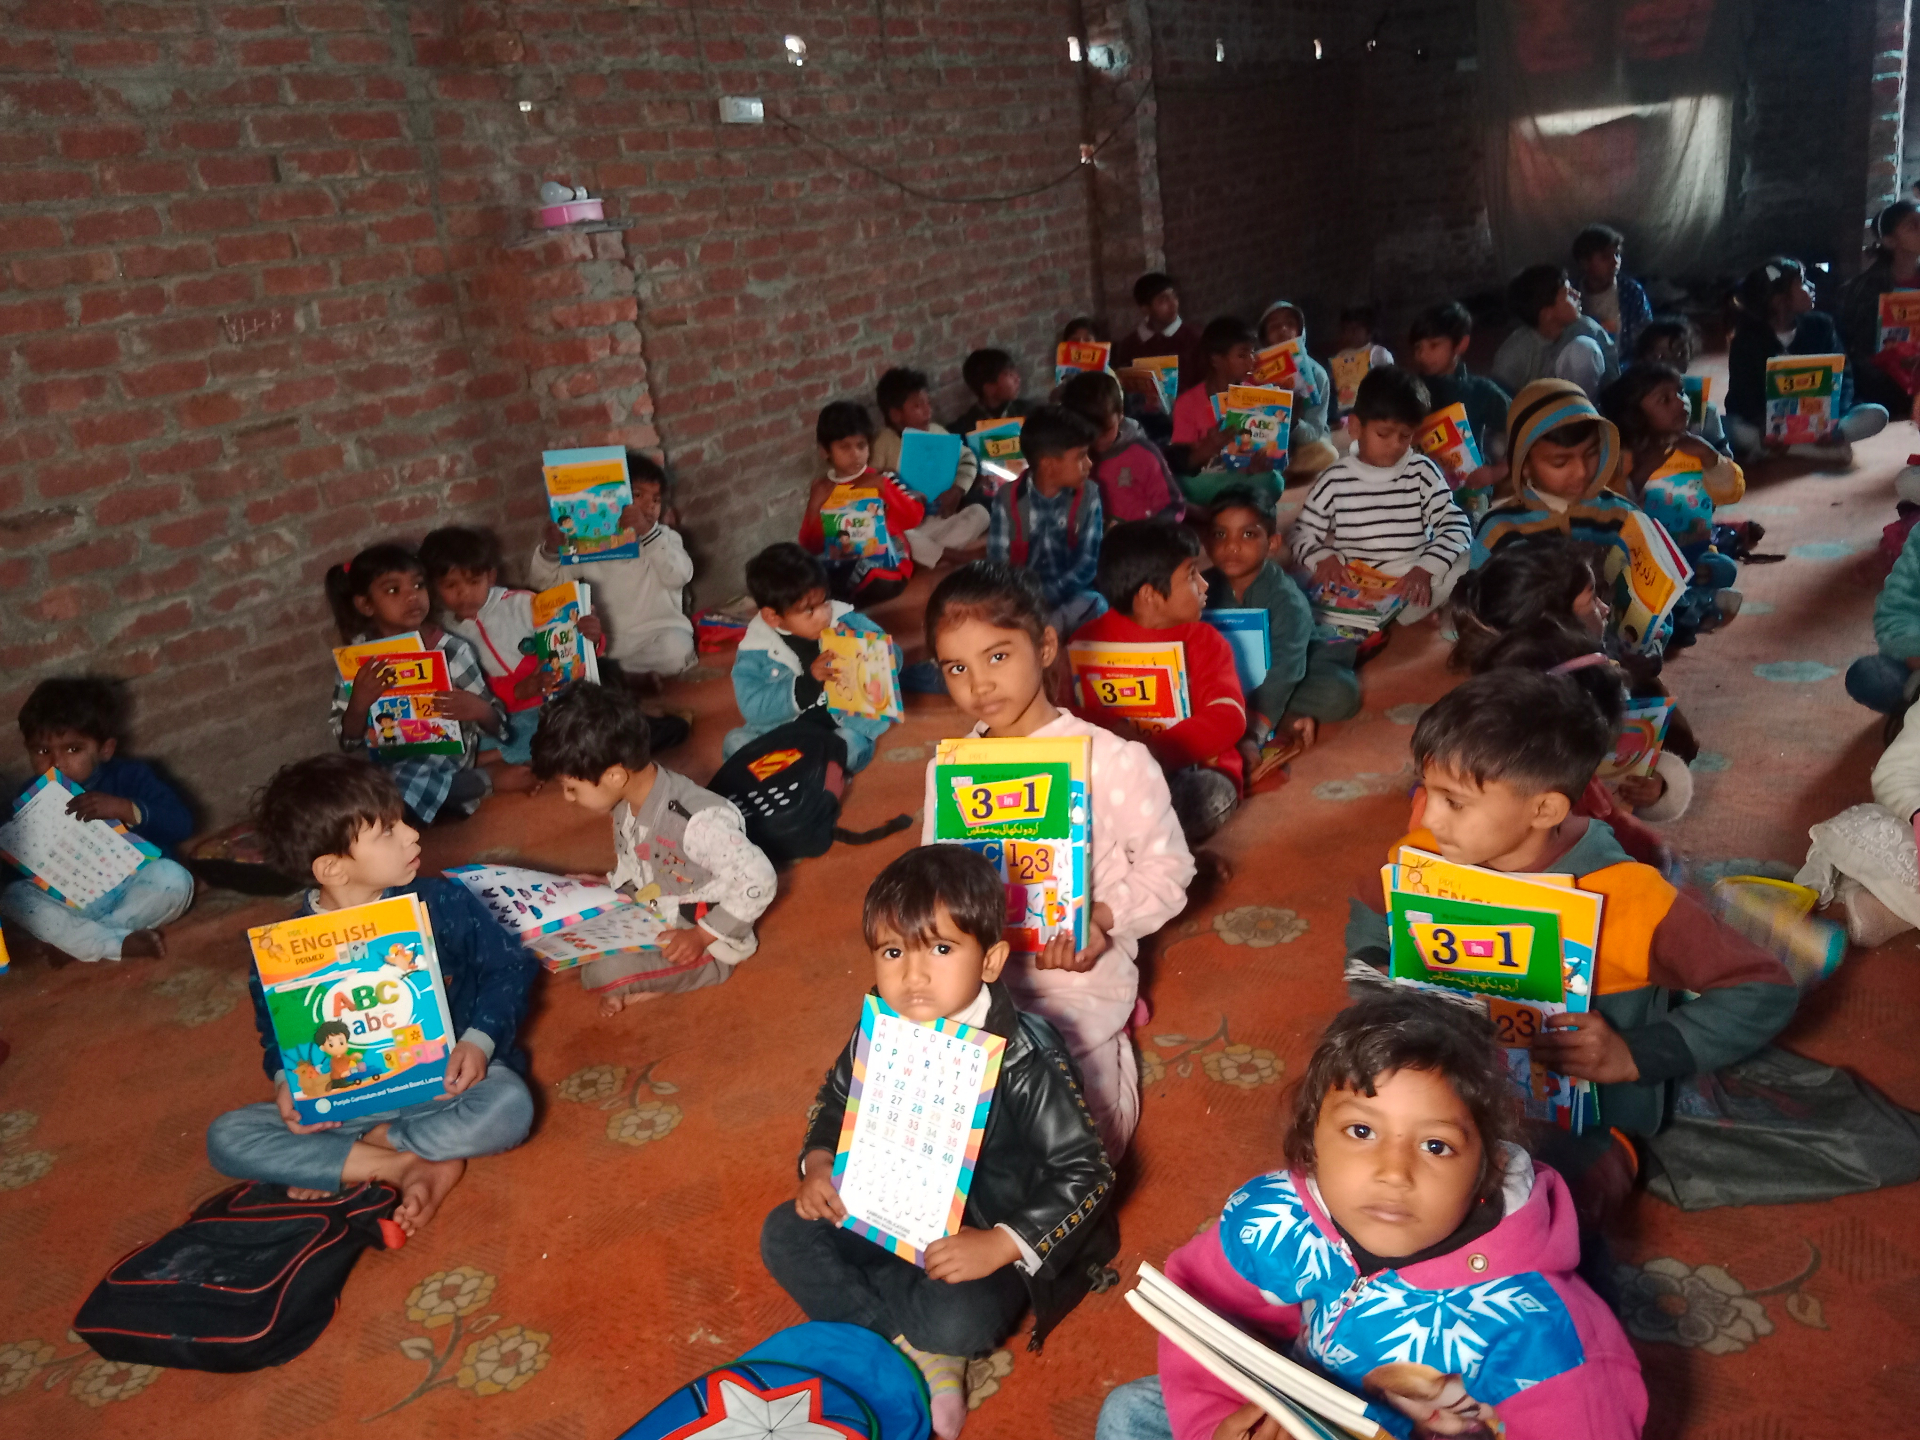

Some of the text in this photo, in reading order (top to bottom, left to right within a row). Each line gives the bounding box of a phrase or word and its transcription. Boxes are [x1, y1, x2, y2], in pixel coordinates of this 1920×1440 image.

[415, 663, 428, 680] 1
[1102, 682, 1118, 703] 3
[1136, 680, 1151, 701] 1
[972, 782, 1040, 819] 3 in 1
[1010, 843, 1050, 879] 123
[290, 922, 378, 955] ENGLISH
[1433, 928, 1458, 965] 3
[1496, 931, 1520, 968] 1
[333, 980, 400, 1017] ABC
[353, 1012, 397, 1036] abc
[913, 1028, 920, 1038] C
[930, 1033, 937, 1043] D
[946, 1039, 952, 1049] E
[973, 1049, 981, 1059] G
[887, 1061, 894, 1070] V
[904, 1067, 912, 1077] W
[892, 1048, 898, 1056] P
[924, 1060, 930, 1069] R
[955, 1071, 960, 1080] T
[953, 1056, 961, 1066] M
[971, 1063, 979, 1072] N
[875, 1072, 886, 1083] 21
[894, 1080, 906, 1091] 22
[933, 1095, 945, 1106] 24
[954, 1103, 966, 1115] 25
[891, 1095, 903, 1106] 27
[911, 1103, 923, 1115] 28
[869, 1103, 880, 1114] 31
[887, 1111, 899, 1122] 32
[908, 1119, 919, 1131] 33
[922, 1143, 934, 1155] 39
[942, 1153, 954, 1164] 40
